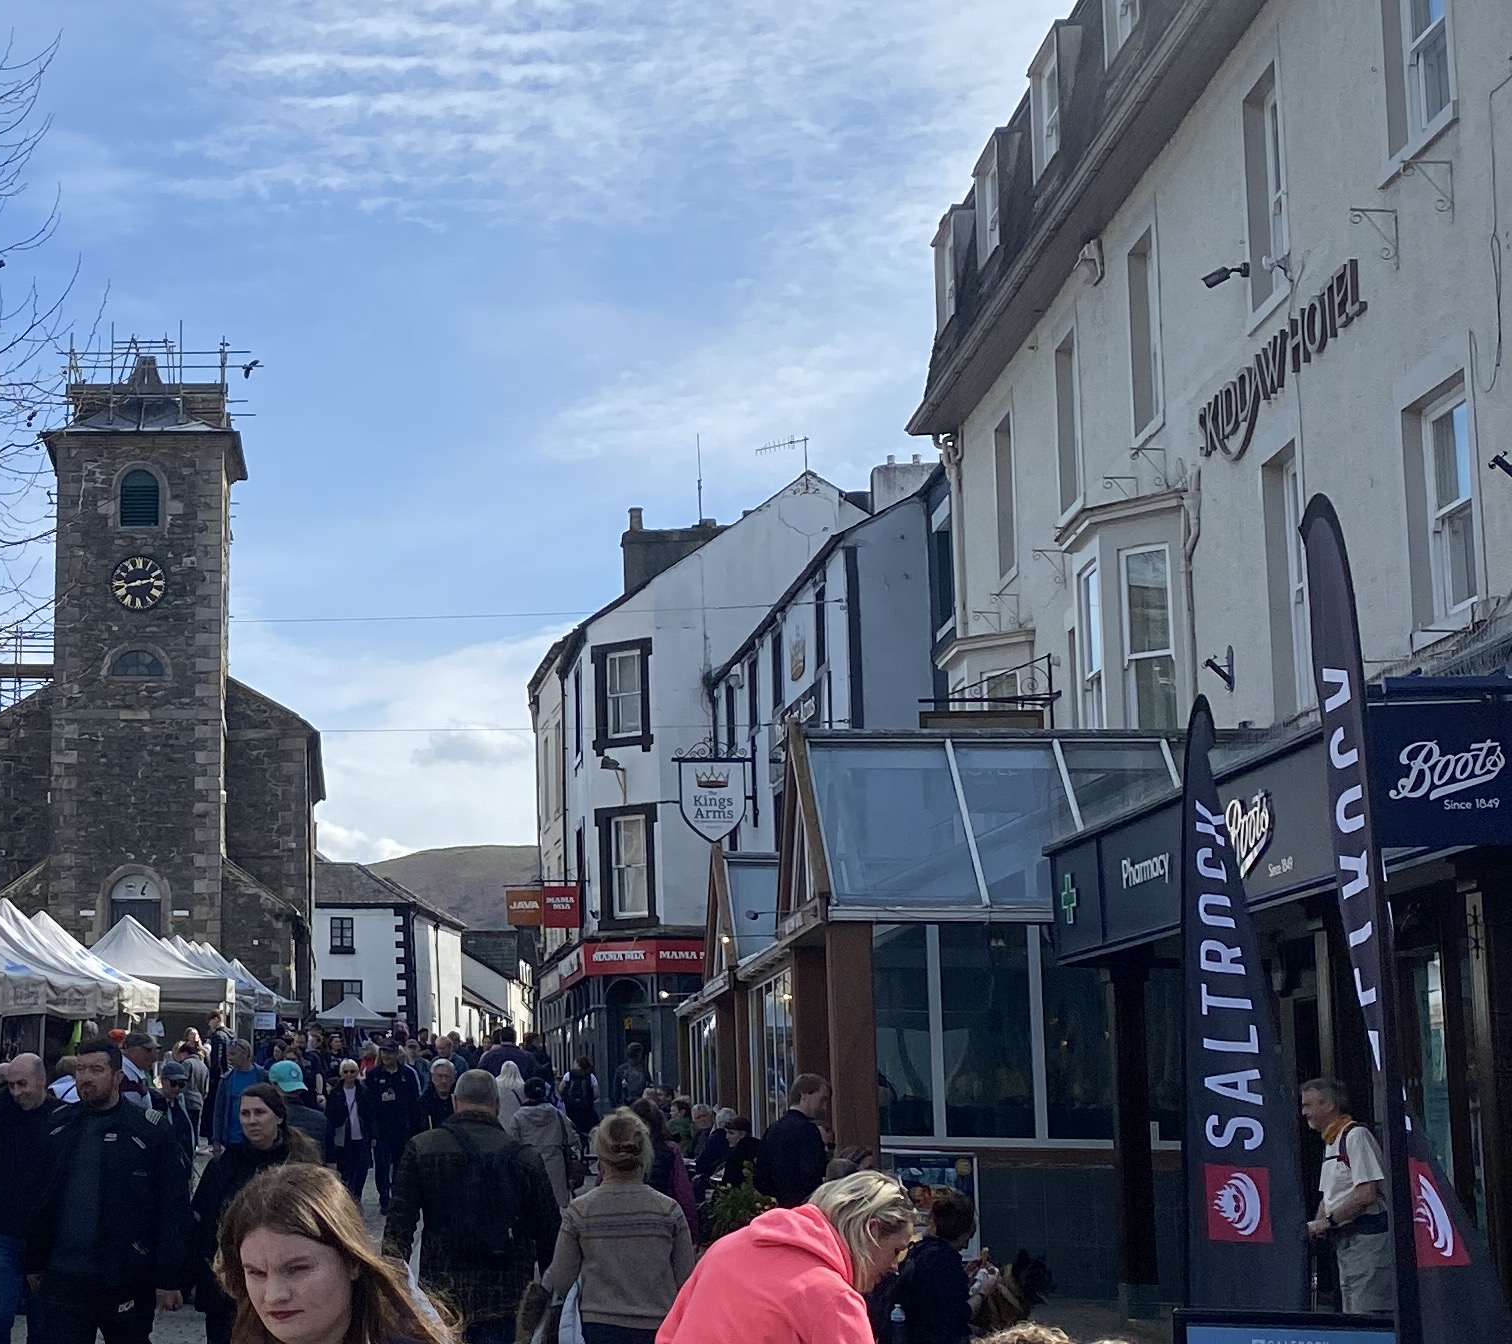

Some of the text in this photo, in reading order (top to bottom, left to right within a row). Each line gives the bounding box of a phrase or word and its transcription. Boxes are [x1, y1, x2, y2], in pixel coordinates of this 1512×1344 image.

[1198, 259, 1368, 461] SKIDDAW HOTEL
[1389, 739, 1505, 801] Boots
[693, 795, 734, 810] Kings
[1444, 798, 1500, 810] Since 1849
[694, 808, 734, 819] Arms
[1226, 789, 1269, 879] Boots
[1121, 852, 1169, 889] Pharmacy
[1268, 862, 1281, 877] Since
[509, 900, 540, 910] JAVA
[546, 896, 575, 904] MAMA
[592, 950, 645, 962] MAMA MIA
[659, 950, 698, 960] MAMA
[1195, 799, 1264, 1150] SALTROCK
